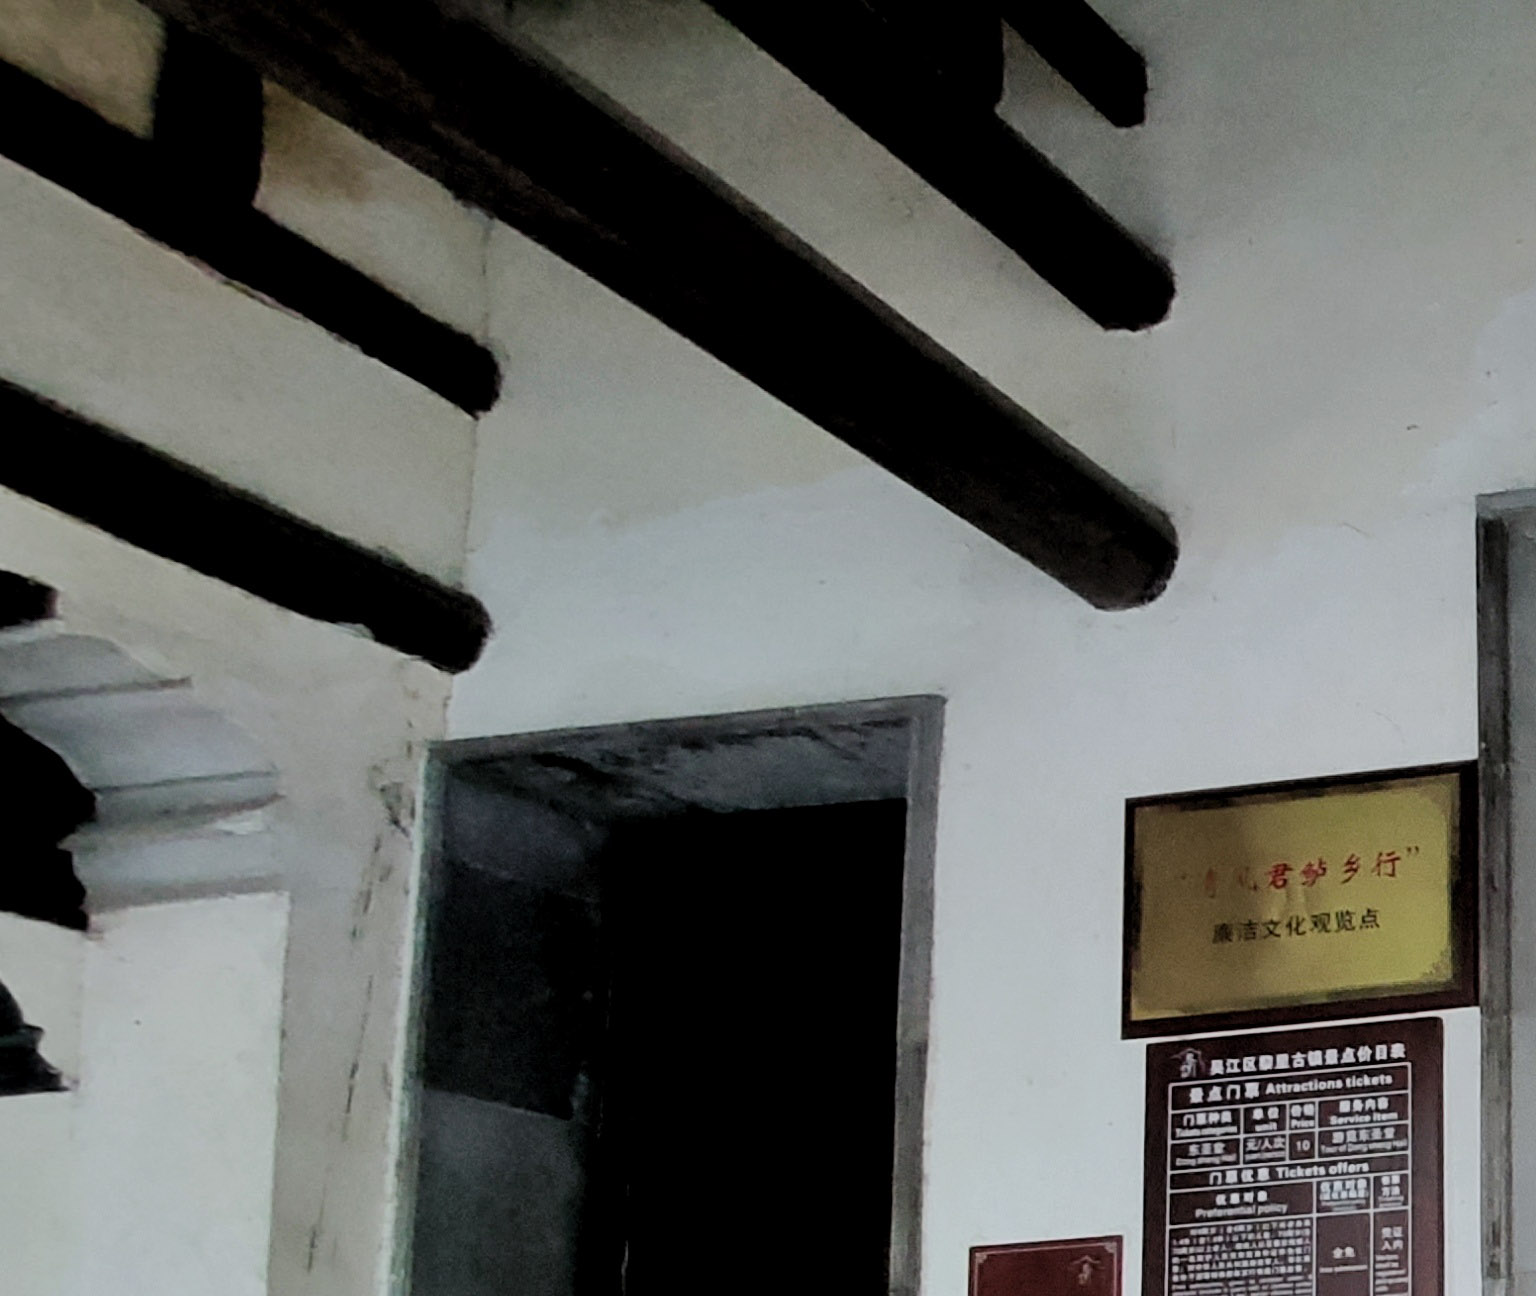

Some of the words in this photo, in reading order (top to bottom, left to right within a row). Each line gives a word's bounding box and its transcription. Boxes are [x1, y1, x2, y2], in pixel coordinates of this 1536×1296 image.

[1212, 907, 1381, 945] 廉洁文化观览点
[1265, 1077, 1344, 1096] Attractions
[1345, 1073, 1393, 1087] tickets
[1296, 1140, 1311, 1151] 10
[1275, 1164, 1327, 1180] Tickets
[1328, 1160, 1370, 1175] offers
